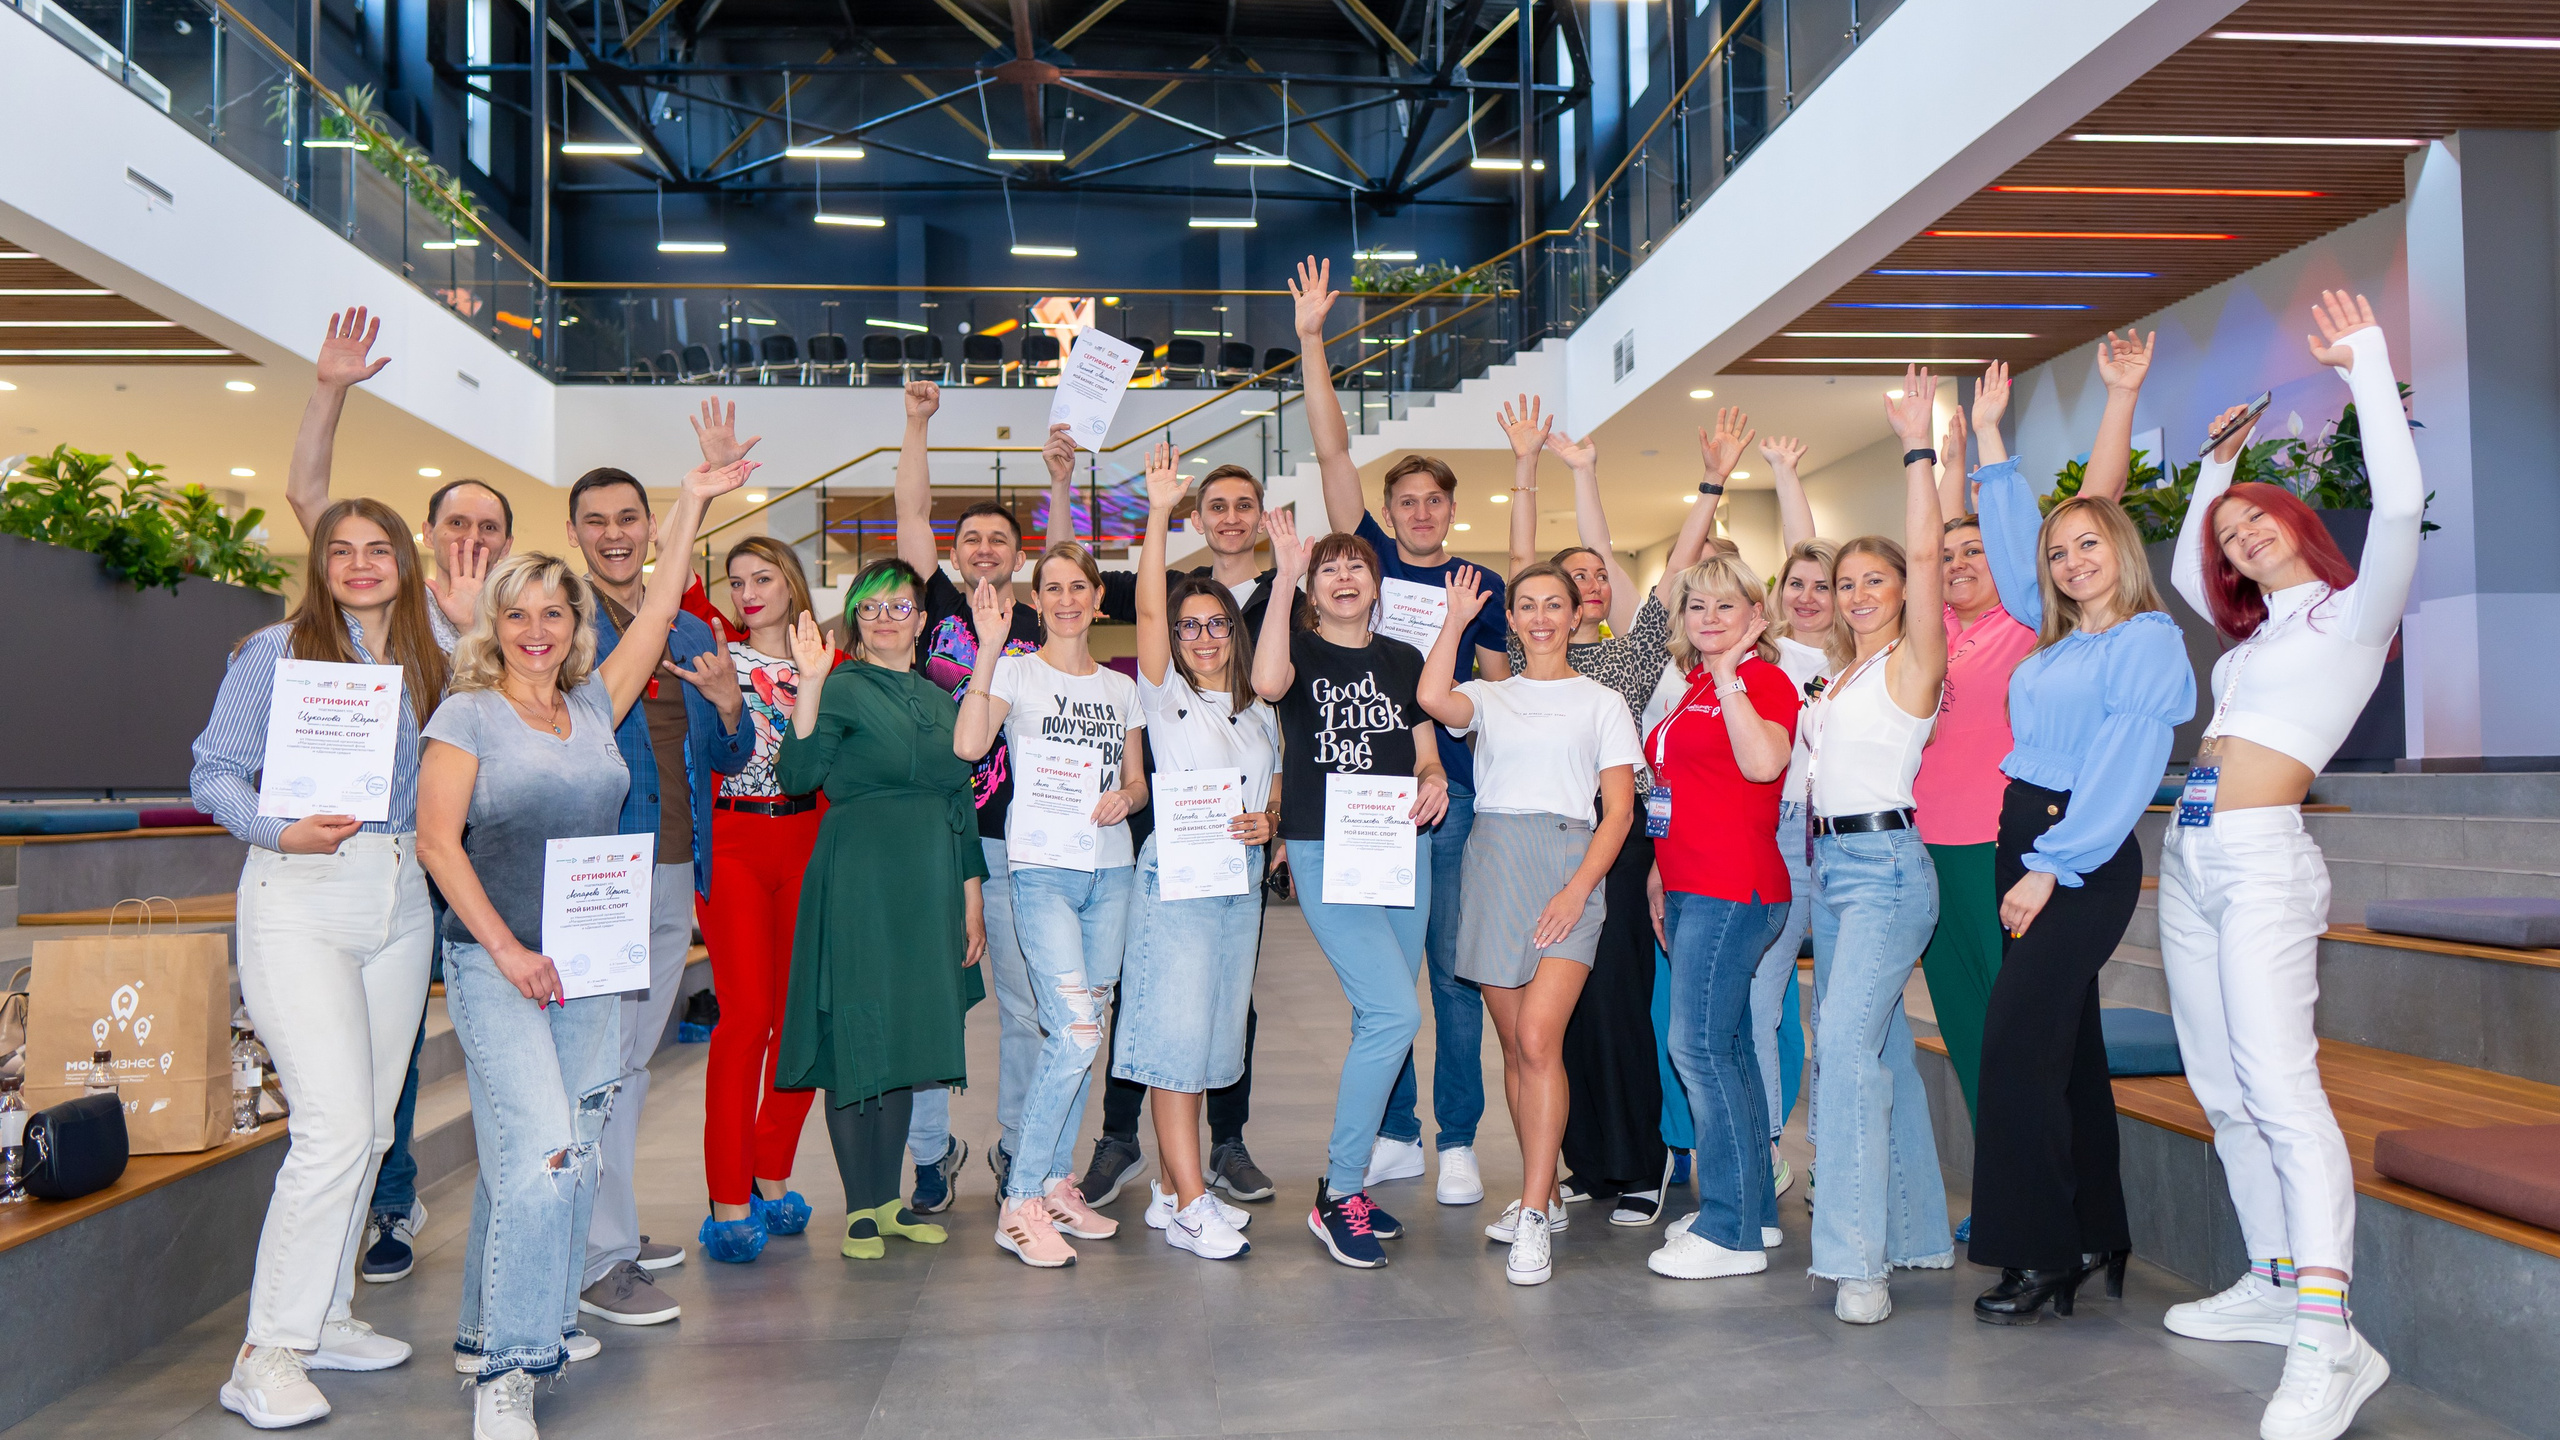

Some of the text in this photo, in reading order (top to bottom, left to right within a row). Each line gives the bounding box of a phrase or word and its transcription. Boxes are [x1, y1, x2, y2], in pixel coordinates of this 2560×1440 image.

[1084, 353, 1116, 371] СЕРТИФИКАТ
[1393, 604, 1433, 616] СЕРТИФИКАТ
[1312, 671, 1386, 707] Good
[302, 696, 370, 707] СЕРТИФИКАТ
[1054, 694, 1116, 721] У МЕНЯ
[1320, 697, 1409, 742] Luck
[315, 729, 345, 737] БИЗНЕС.
[1314, 730, 1373, 773] Bae
[1036, 766, 1081, 779] СЕРТИФИКАТ
[1175, 797, 1221, 807] СЕРТИФИКАТ
[1347, 803, 1396, 811] СЕРТИФИКАТ
[571, 870, 627, 882] СЕРТИФИКАТ
[566, 906, 581, 914] МОЙ
[582, 904, 608, 912] БИЗНЕС.
